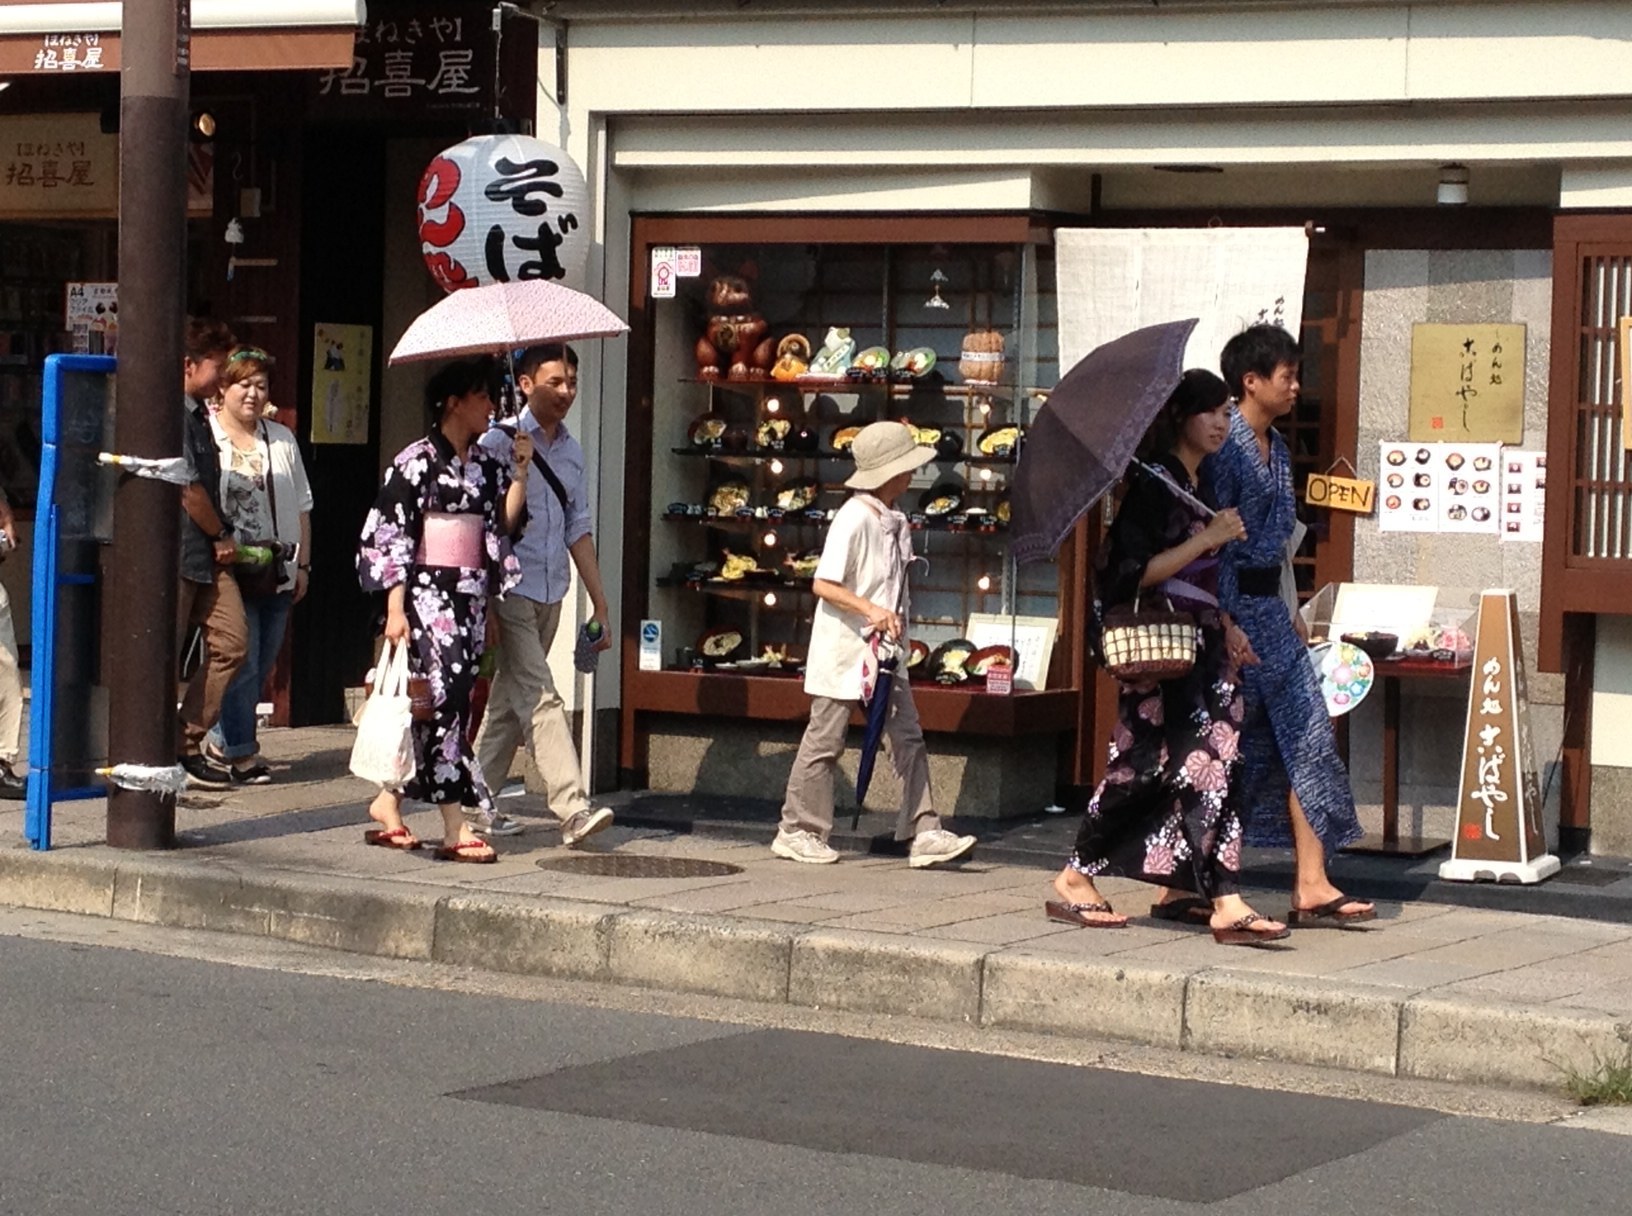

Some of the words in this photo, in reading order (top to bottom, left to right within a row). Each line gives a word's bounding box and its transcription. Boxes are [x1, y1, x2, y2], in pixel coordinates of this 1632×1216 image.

[34, 48, 104, 70] 招喜屋
[320, 50, 479, 98] 招喜屋
[6, 160, 94, 187] 招喜屋
[485, 157, 578, 283] そば
[1309, 478, 1371, 507] OPEN
